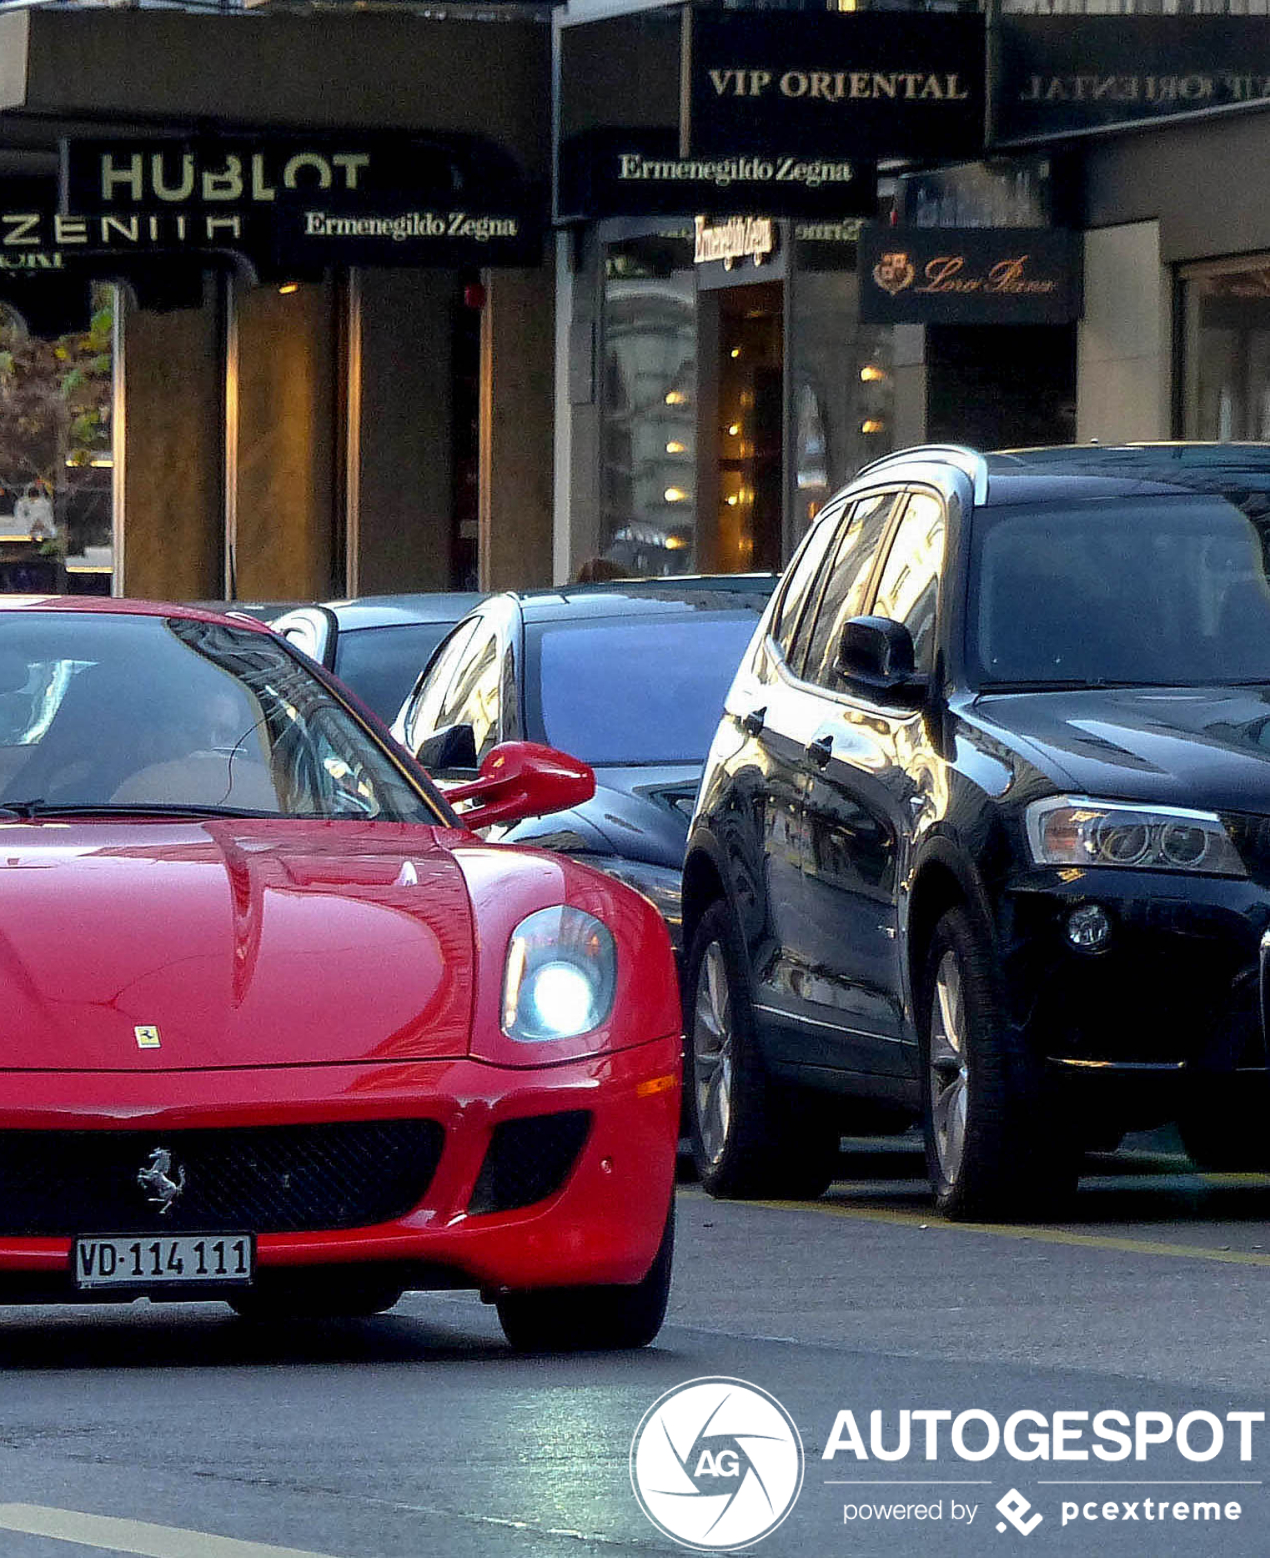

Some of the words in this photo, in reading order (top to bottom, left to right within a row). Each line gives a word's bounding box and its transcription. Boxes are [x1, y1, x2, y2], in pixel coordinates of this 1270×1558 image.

[708, 69, 772, 97] VIP
[779, 71, 968, 102] ORIENTAL
[101, 153, 370, 201] HUBLOT
[618, 153, 773, 187] Ermenegildo
[775, 157, 852, 188] Zegna
[304, 211, 444, 242] Ermenegildo
[446, 212, 518, 242] Zegna
[193, 1240, 247, 1275] 111
